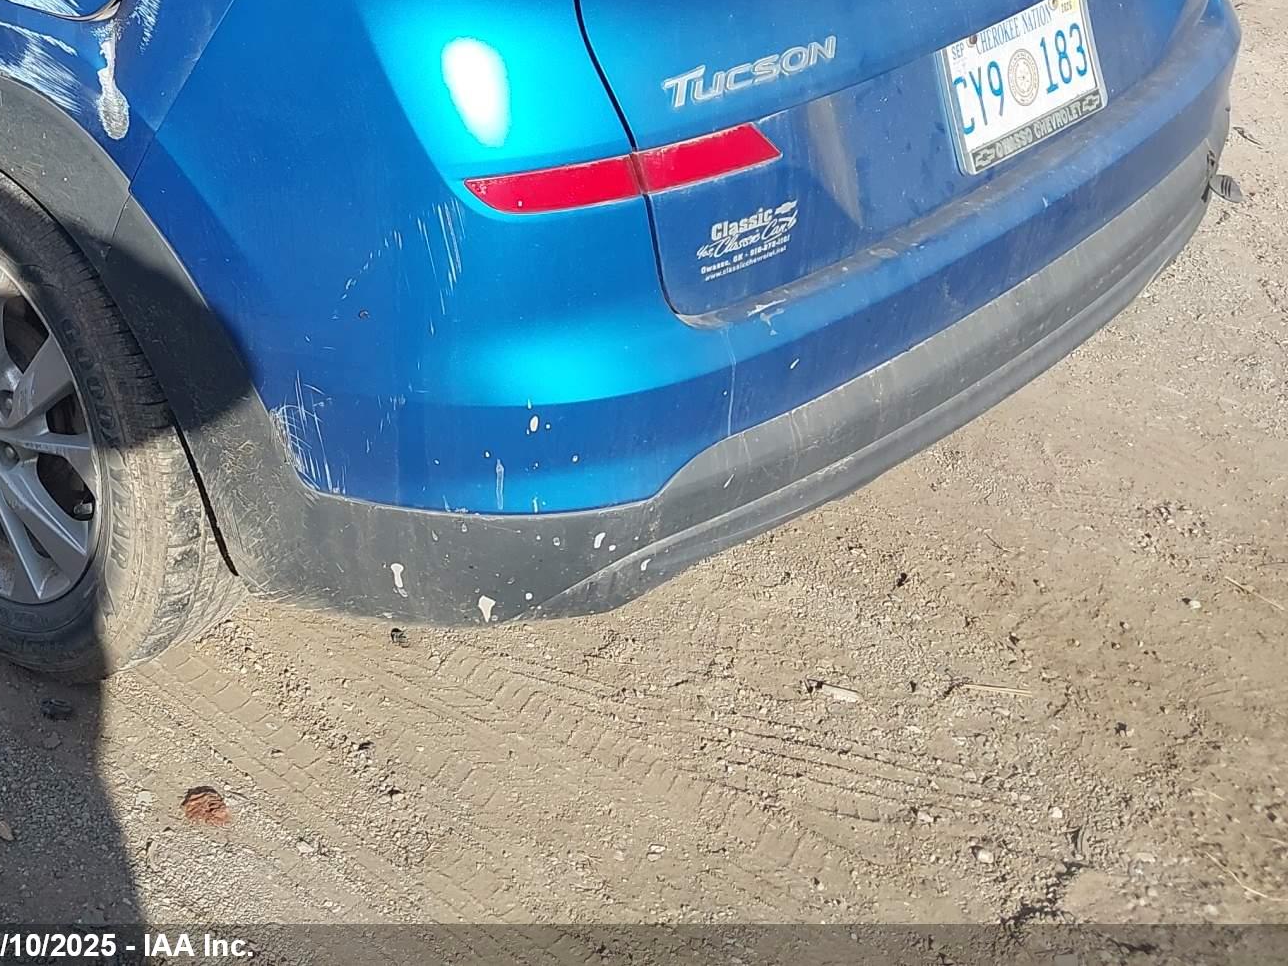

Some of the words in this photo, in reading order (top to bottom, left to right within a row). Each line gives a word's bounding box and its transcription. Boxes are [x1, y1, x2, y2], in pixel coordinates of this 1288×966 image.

[976, 17, 1022, 54] CHEROKEE
[1021, 3, 1054, 37] NATION
[953, 60, 1006, 135] CY9
[1040, 22, 1088, 94] 183
[1033, 101, 1083, 139] CHEVROLET
[711, 208, 773, 241] Classic
